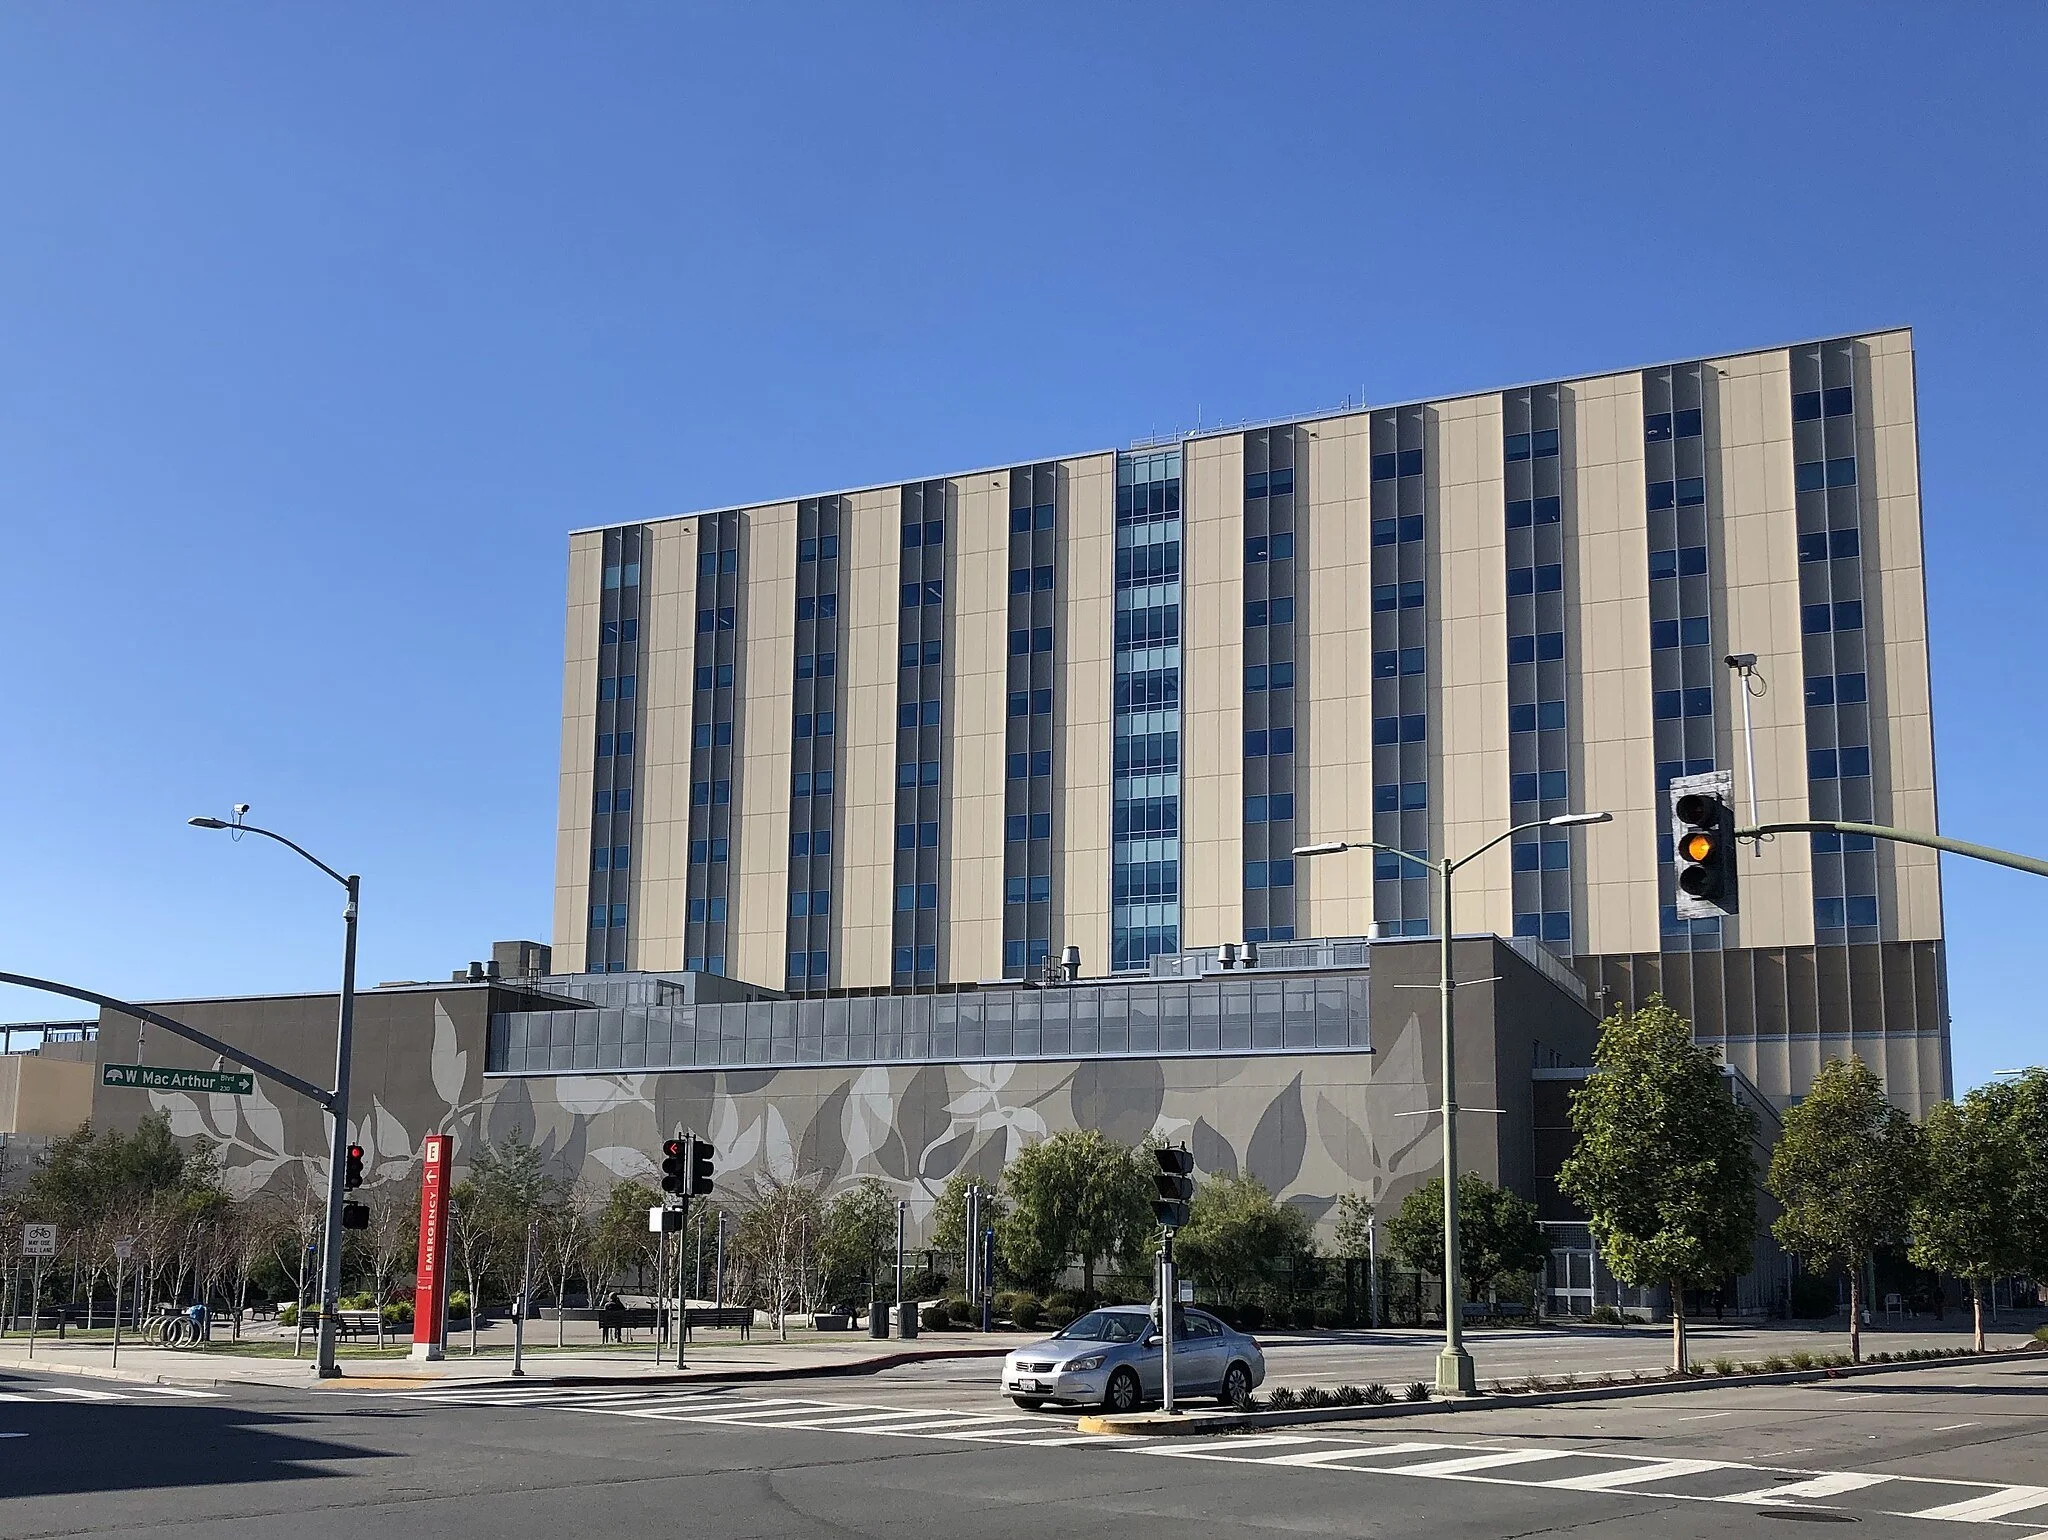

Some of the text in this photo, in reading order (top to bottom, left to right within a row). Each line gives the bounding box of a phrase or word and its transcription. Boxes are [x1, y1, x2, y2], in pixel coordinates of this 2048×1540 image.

[125, 1069, 137, 1083] W
[220, 1074, 234, 1082] Blvd
[430, 1146, 435, 1158] E
[425, 1192, 437, 1271] EMERGENCY
